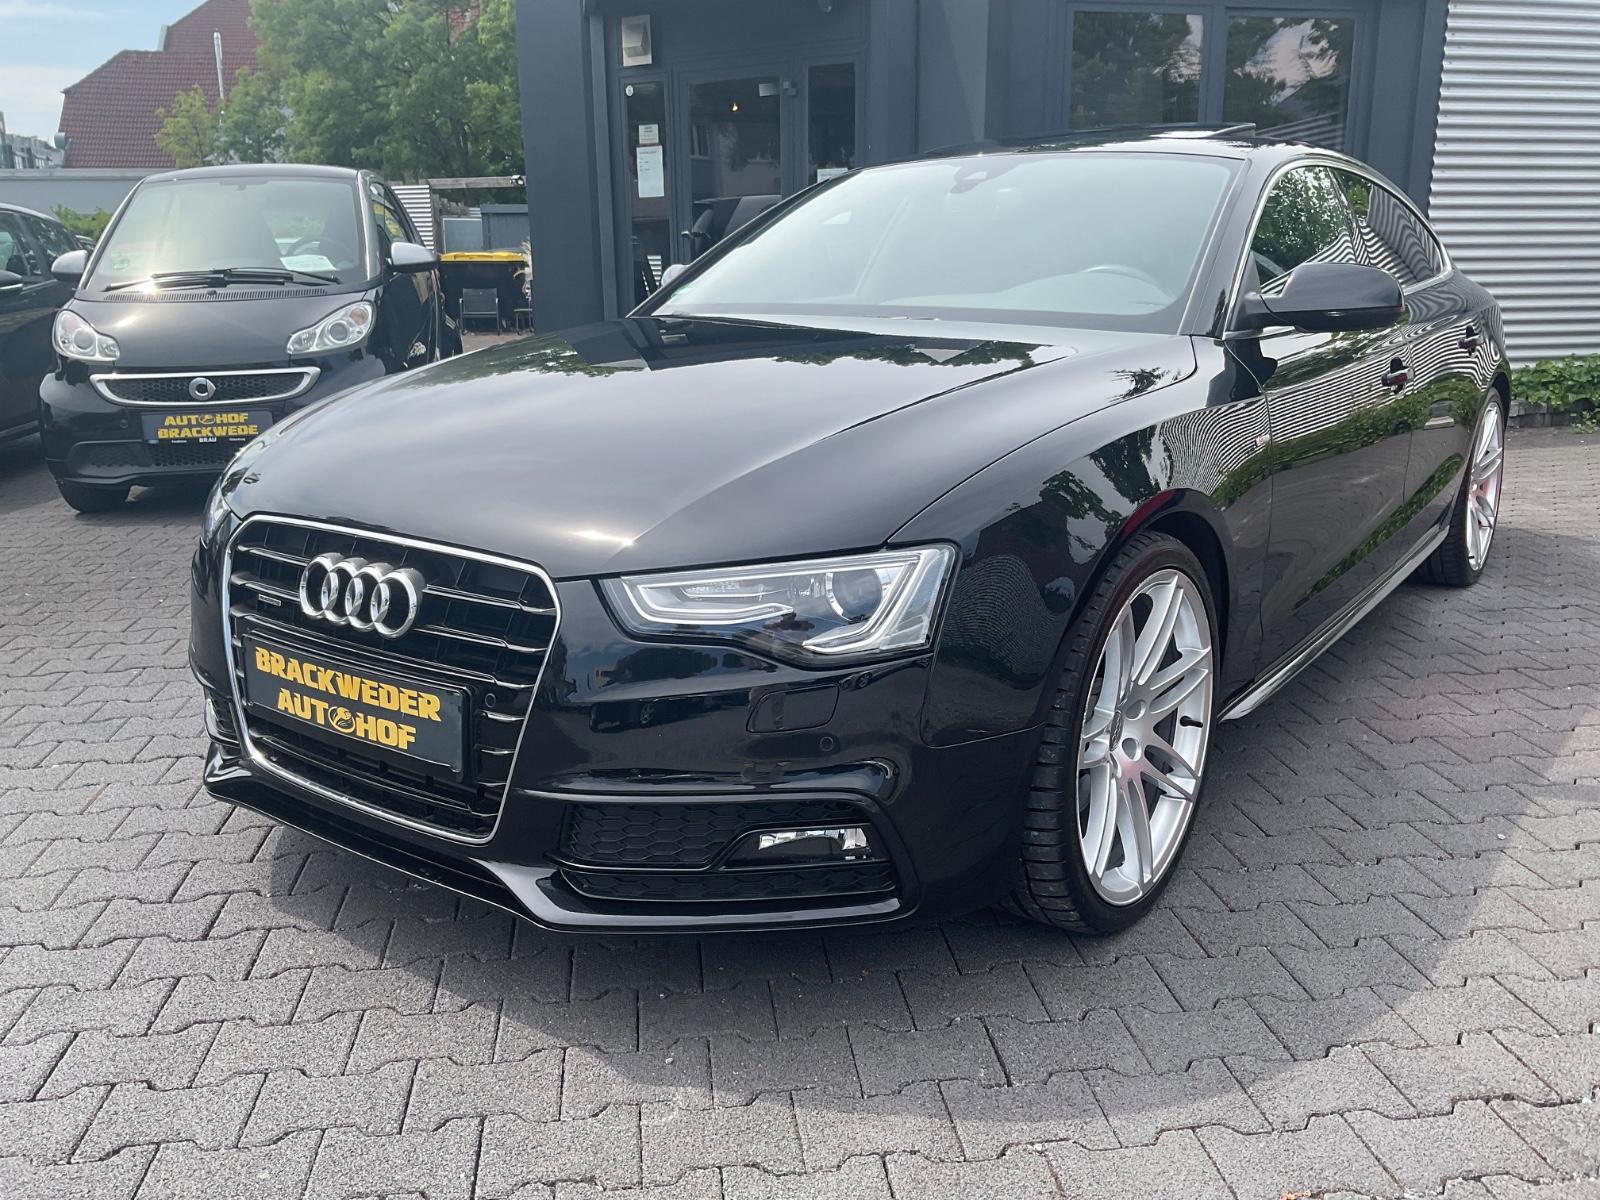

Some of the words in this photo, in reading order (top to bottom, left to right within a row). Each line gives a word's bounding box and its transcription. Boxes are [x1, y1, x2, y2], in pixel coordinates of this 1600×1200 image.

[158, 425, 259, 439] BRACKWEDE
[255, 646, 442, 722] BRACKWEDER
[277, 687, 417, 750] AUTOHOF
